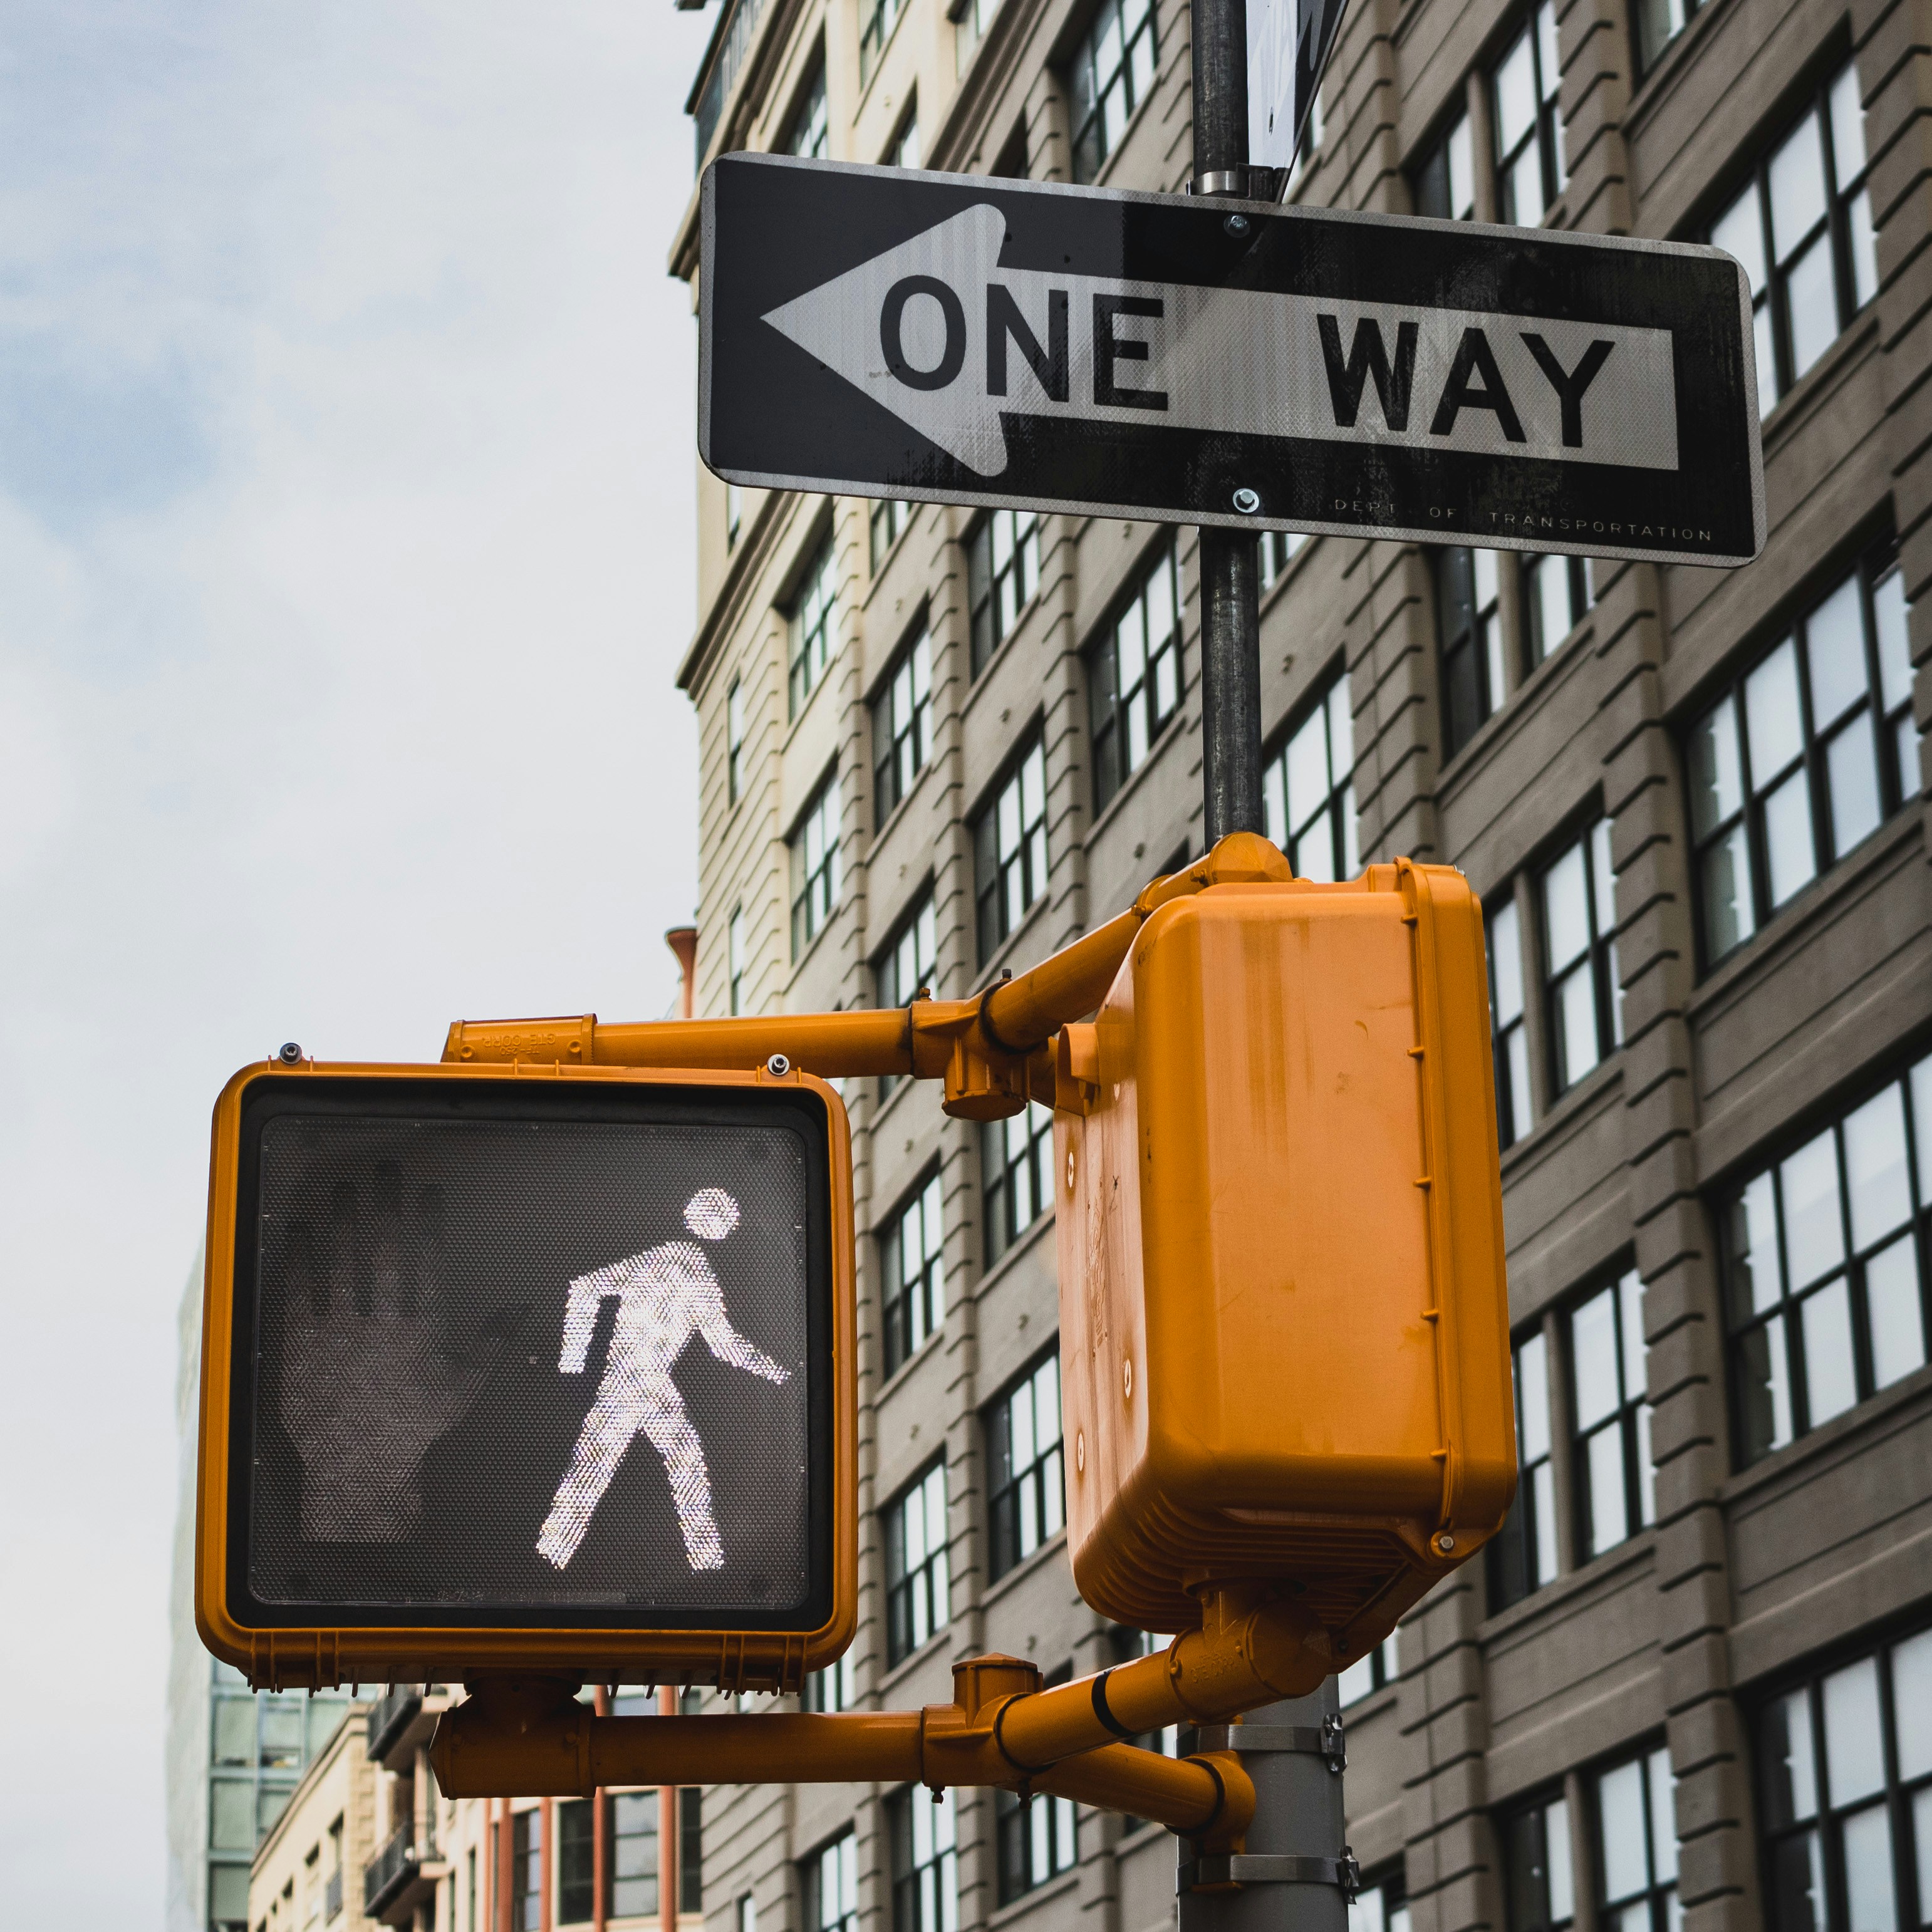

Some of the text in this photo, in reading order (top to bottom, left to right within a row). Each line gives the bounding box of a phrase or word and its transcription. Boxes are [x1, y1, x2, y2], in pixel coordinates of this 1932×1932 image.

[880, 274, 1616, 449] ONE WAY
[1334, 499, 1711, 541] DEPT OF TRANSPORTATION
